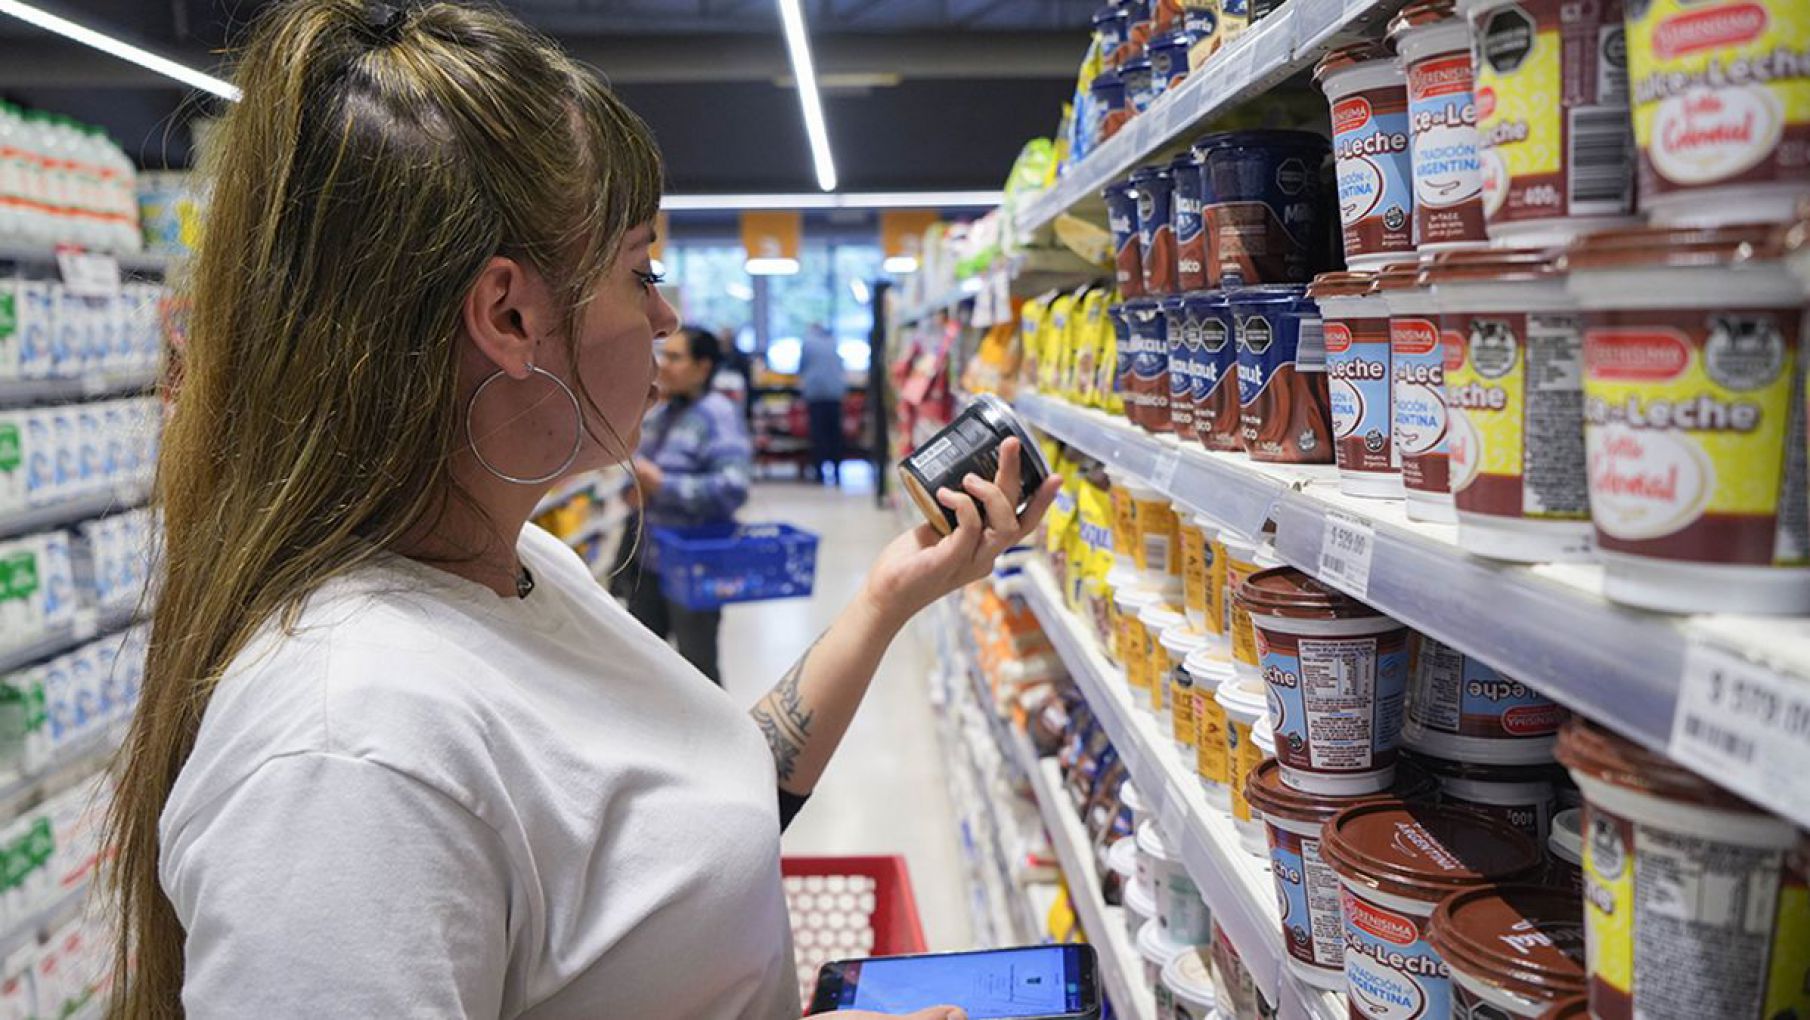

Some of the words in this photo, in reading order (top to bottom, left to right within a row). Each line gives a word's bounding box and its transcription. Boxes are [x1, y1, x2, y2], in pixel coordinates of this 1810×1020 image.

[1343, 132, 1407, 157] Leche
[1627, 393, 1759, 430] Leche
[1376, 944, 1451, 976] Leche
